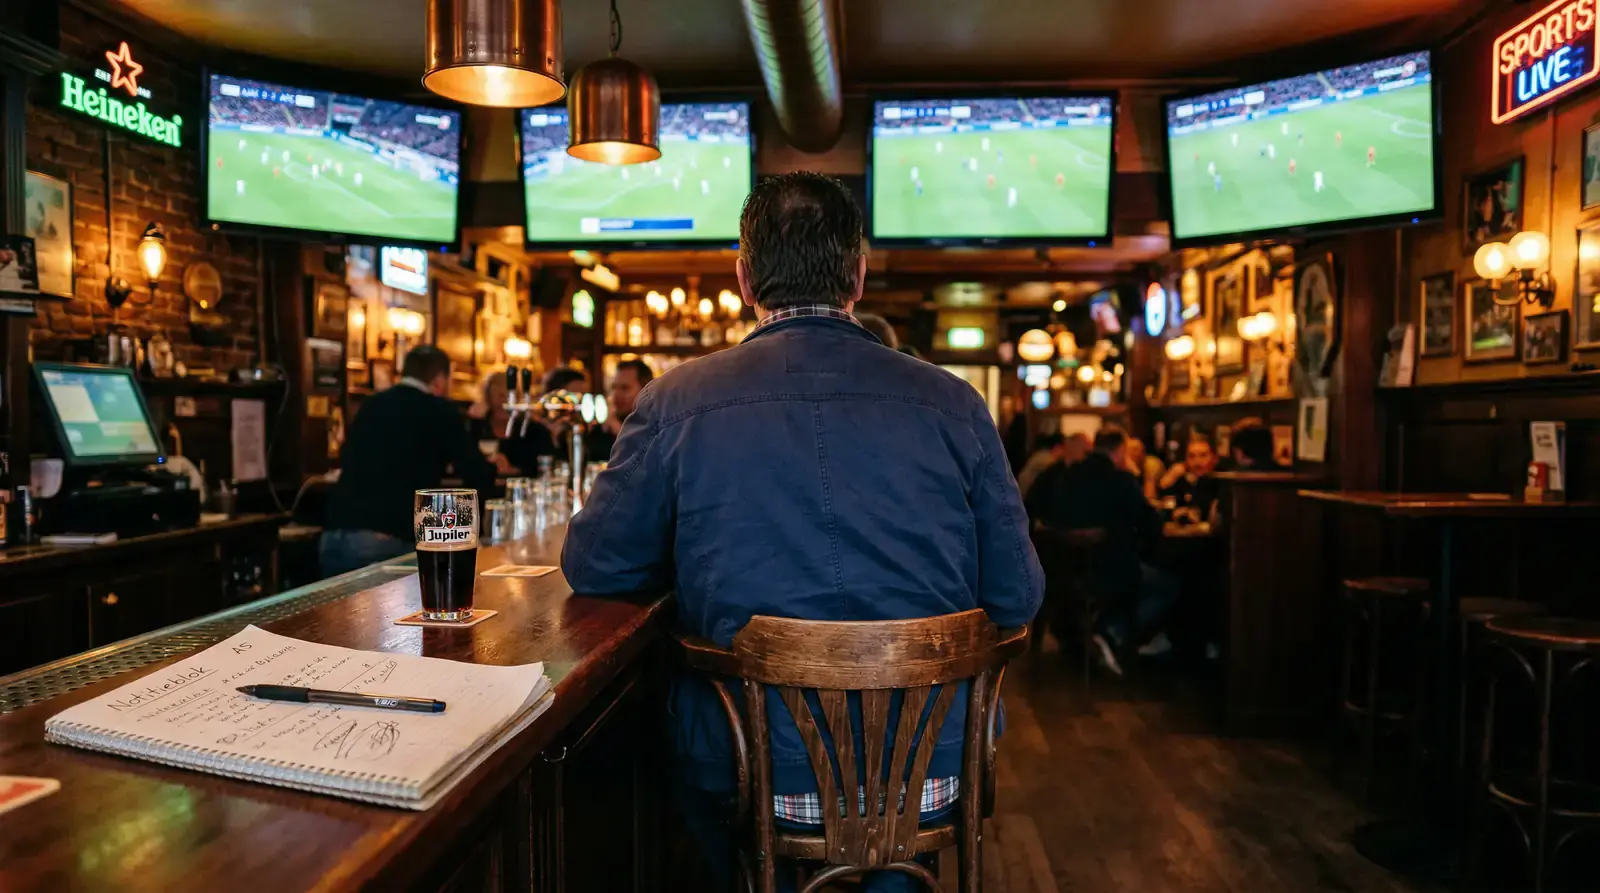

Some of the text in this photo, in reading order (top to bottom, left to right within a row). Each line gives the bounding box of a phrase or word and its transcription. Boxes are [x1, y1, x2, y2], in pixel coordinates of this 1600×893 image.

[1500, 0, 1594, 75] SPORTS
[1518, 45, 1571, 101] LIVE
[61, 71, 182, 147] Heineken
[428, 529, 470, 542] Jupiler
[106, 667, 214, 712] Notitieblok
[380, 699, 398, 707] BIC
